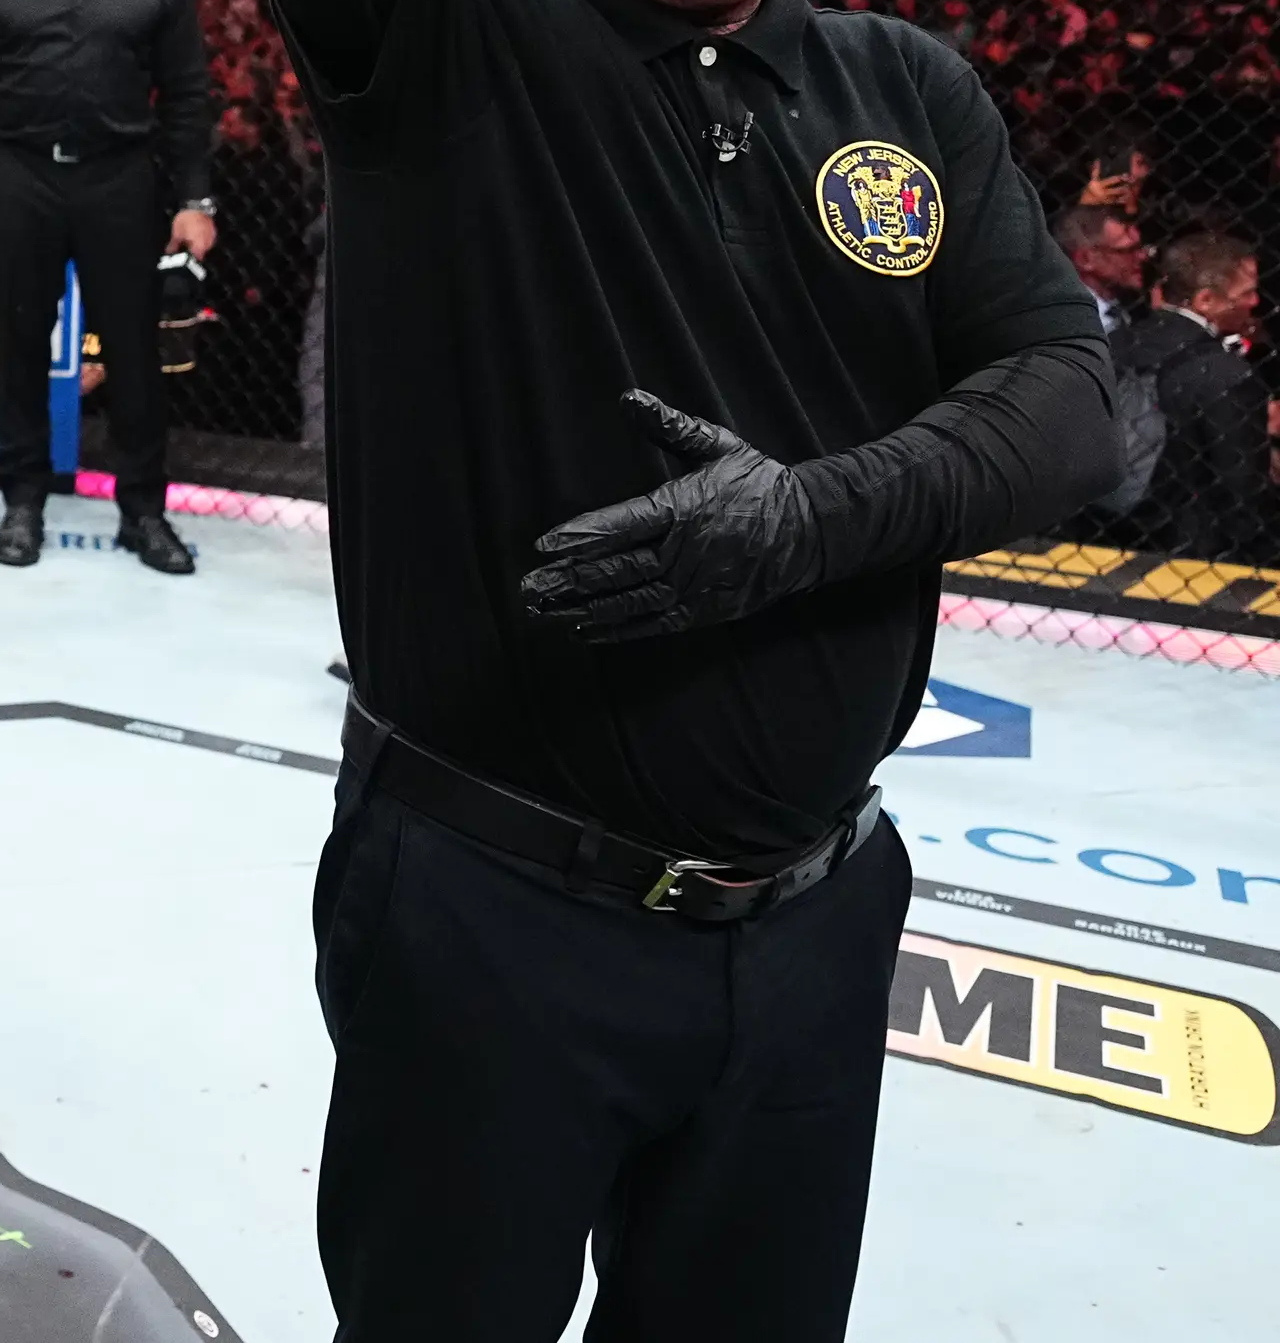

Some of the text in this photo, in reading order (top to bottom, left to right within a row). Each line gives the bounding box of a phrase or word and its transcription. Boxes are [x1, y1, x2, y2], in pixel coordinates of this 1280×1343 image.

[832, 148, 920, 178] NEW JERSEY
[826, 200, 940, 269] ATHLETIC CONTROL BOARD
